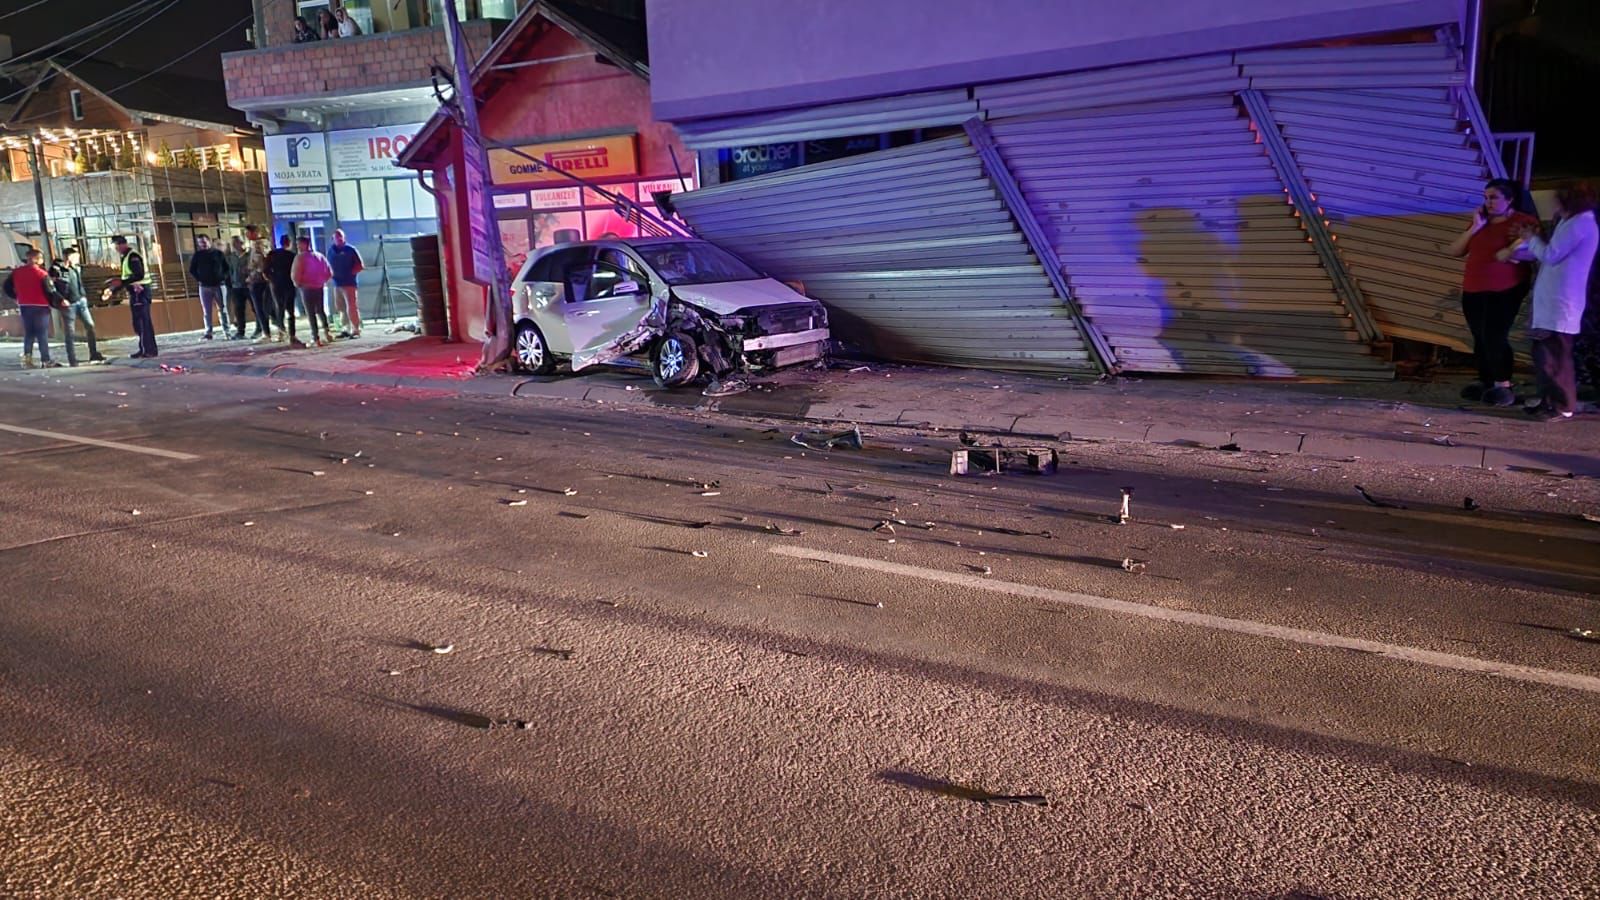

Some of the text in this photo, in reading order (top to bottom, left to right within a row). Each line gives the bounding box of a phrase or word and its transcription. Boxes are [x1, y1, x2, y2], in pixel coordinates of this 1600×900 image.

[368, 134, 415, 160] IRO
[510, 147, 609, 174] GOMME PIRELLI
[273, 170, 322, 180] MOJA VRATA
[534, 191, 576, 201] VULKANIZER
